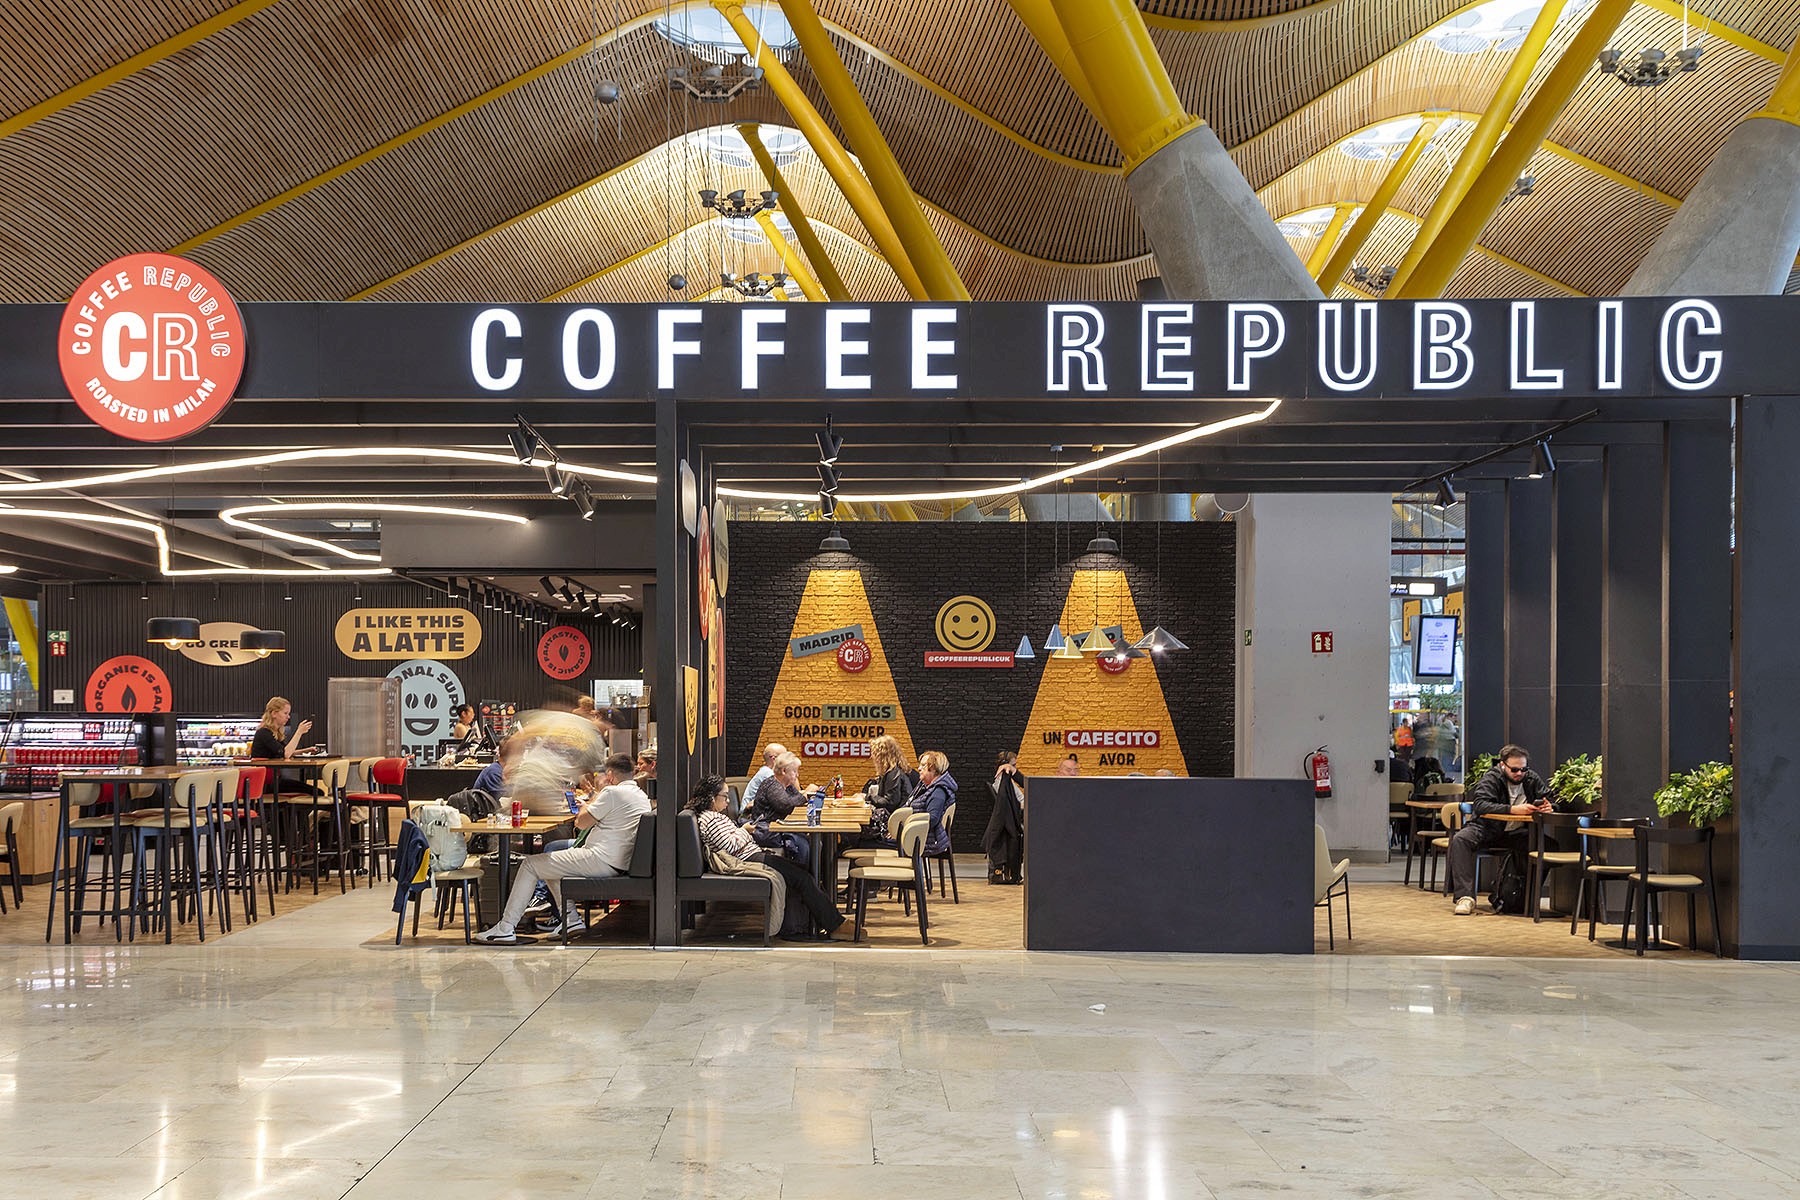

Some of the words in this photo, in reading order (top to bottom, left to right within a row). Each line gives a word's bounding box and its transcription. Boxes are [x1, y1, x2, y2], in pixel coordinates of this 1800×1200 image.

[72, 271, 132, 355] COFFEE
[143, 266, 231, 357] REPUBLIC
[101, 311, 200, 382] CR
[470, 308, 958, 391] COFFEE
[1046, 301, 1723, 392] REPUBLIC
[86, 377, 148, 423] ROASTED
[153, 408, 170, 423] IN
[172, 377, 217, 418] MILAN
[354, 616, 361, 628] I
[366, 616, 412, 628] LIKE
[417, 615, 465, 628] THIS
[352, 632, 372, 652] A
[379, 632, 464, 652] LATTE
[928, 655, 1010, 663] @COFFEEREPUBLICUK
[95, 665, 139, 711] ORGANIC
[141, 670, 155, 683] IS
[784, 706, 821, 719] GOOD
[827, 706, 891, 719] THINGS
[793, 725, 847, 738] HAPPEN
[850, 725, 885, 738] OVER
[1043, 731, 1061, 745] UN
[1067, 731, 1157, 746] CAFECITO
[804, 742, 871, 757] COFFEE
